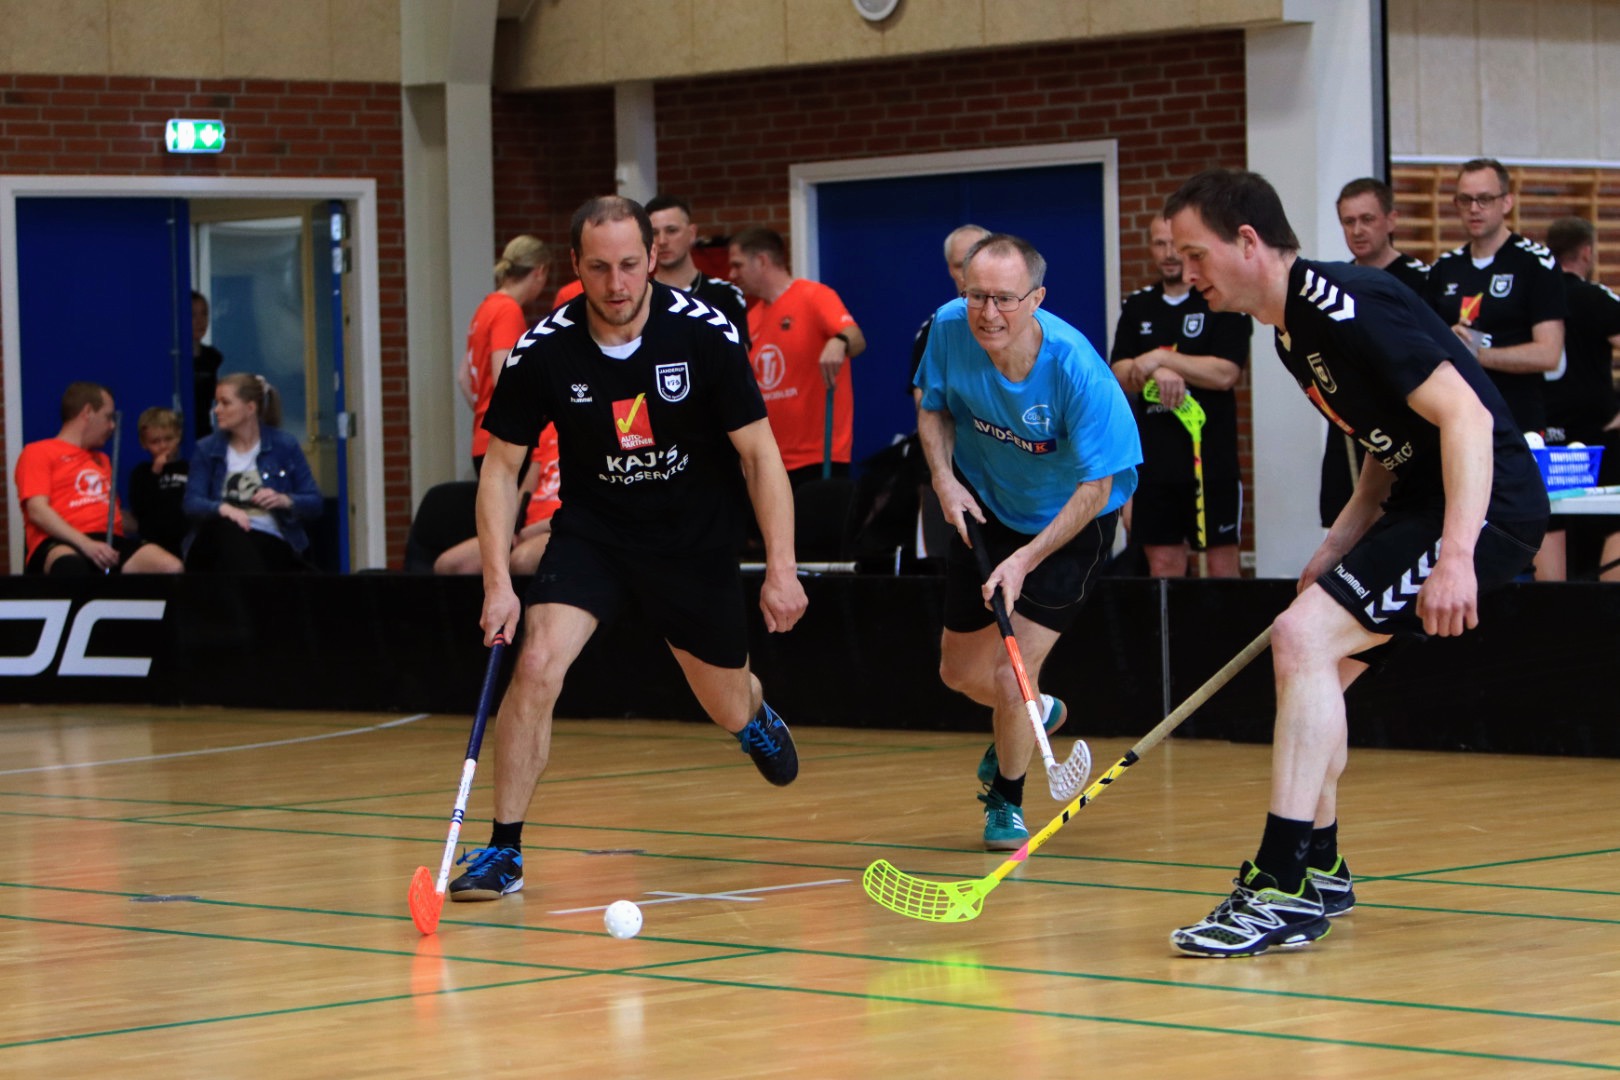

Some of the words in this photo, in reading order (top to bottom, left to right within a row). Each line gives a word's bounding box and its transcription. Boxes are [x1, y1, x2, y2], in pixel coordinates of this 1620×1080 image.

[621, 438, 653, 449] PARTNER
[974, 418, 1033, 453] AVIDSEN
[598, 454, 689, 485] AUTOSERVICE
[606, 444, 678, 474] KAJ'S
[1334, 562, 1371, 599] hummel
